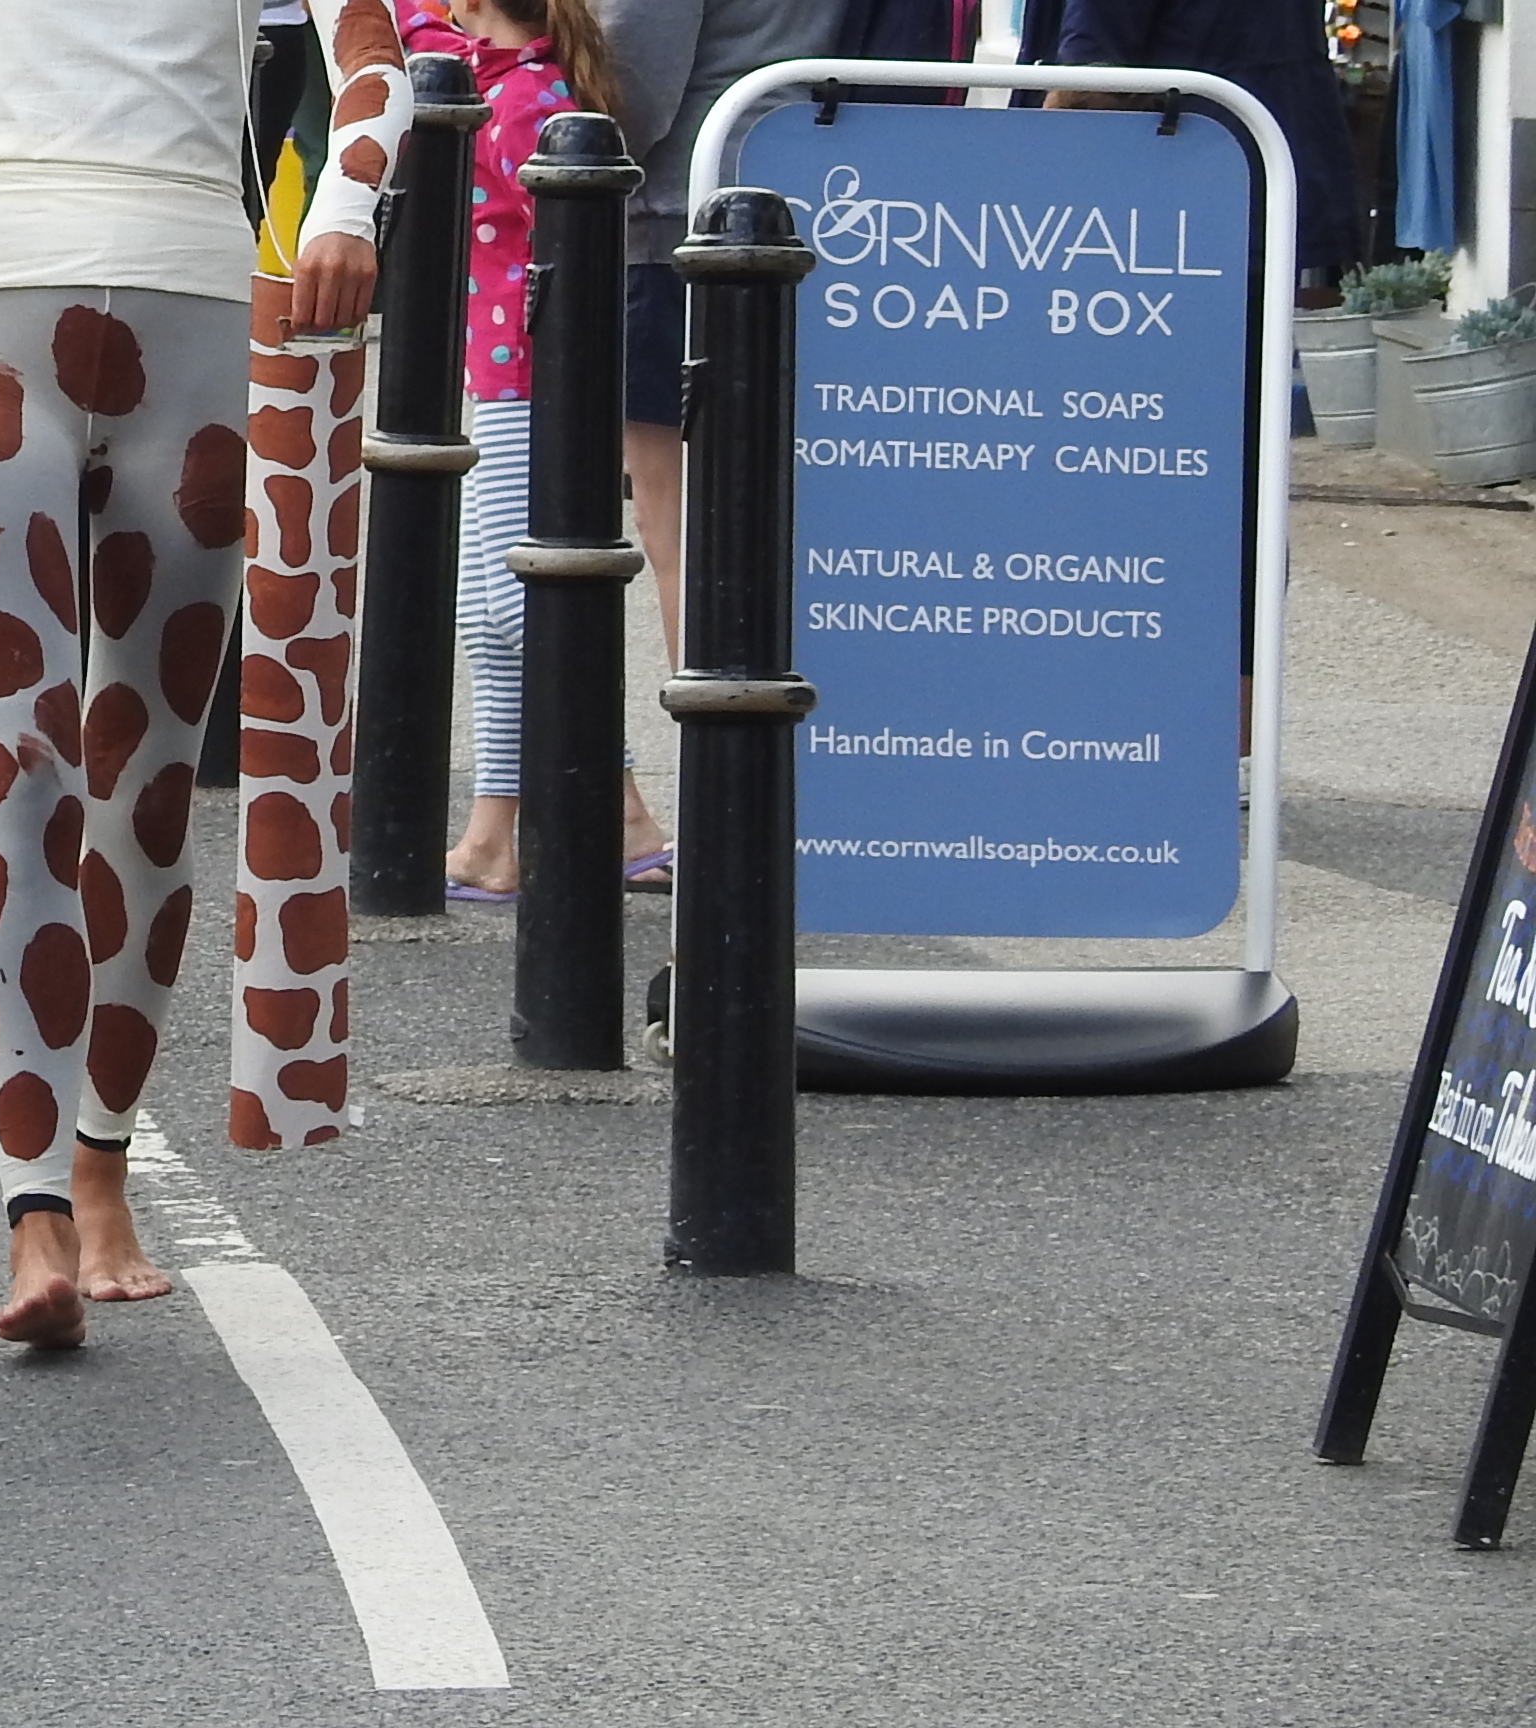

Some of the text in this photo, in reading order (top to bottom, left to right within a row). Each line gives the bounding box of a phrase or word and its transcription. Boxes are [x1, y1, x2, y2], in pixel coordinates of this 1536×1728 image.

[784, 188, 1223, 277] ORNWALL
[824, 282, 1174, 337] SOAP BOX
[813, 383, 1165, 422] TRADITIONAL SOAPS
[793, 436, 1209, 477] ROMATHERAPY CANDLES
[807, 547, 1166, 585] NATURAL & ORGANIC
[807, 602, 1163, 640] SKINCARE PRODUCTS
[808, 725, 1162, 763] Handmade in Cornwall
[794, 835, 1181, 868] www.cornwallsoapbox.co.uk
[1485, 899, 1528, 1007] Tea
